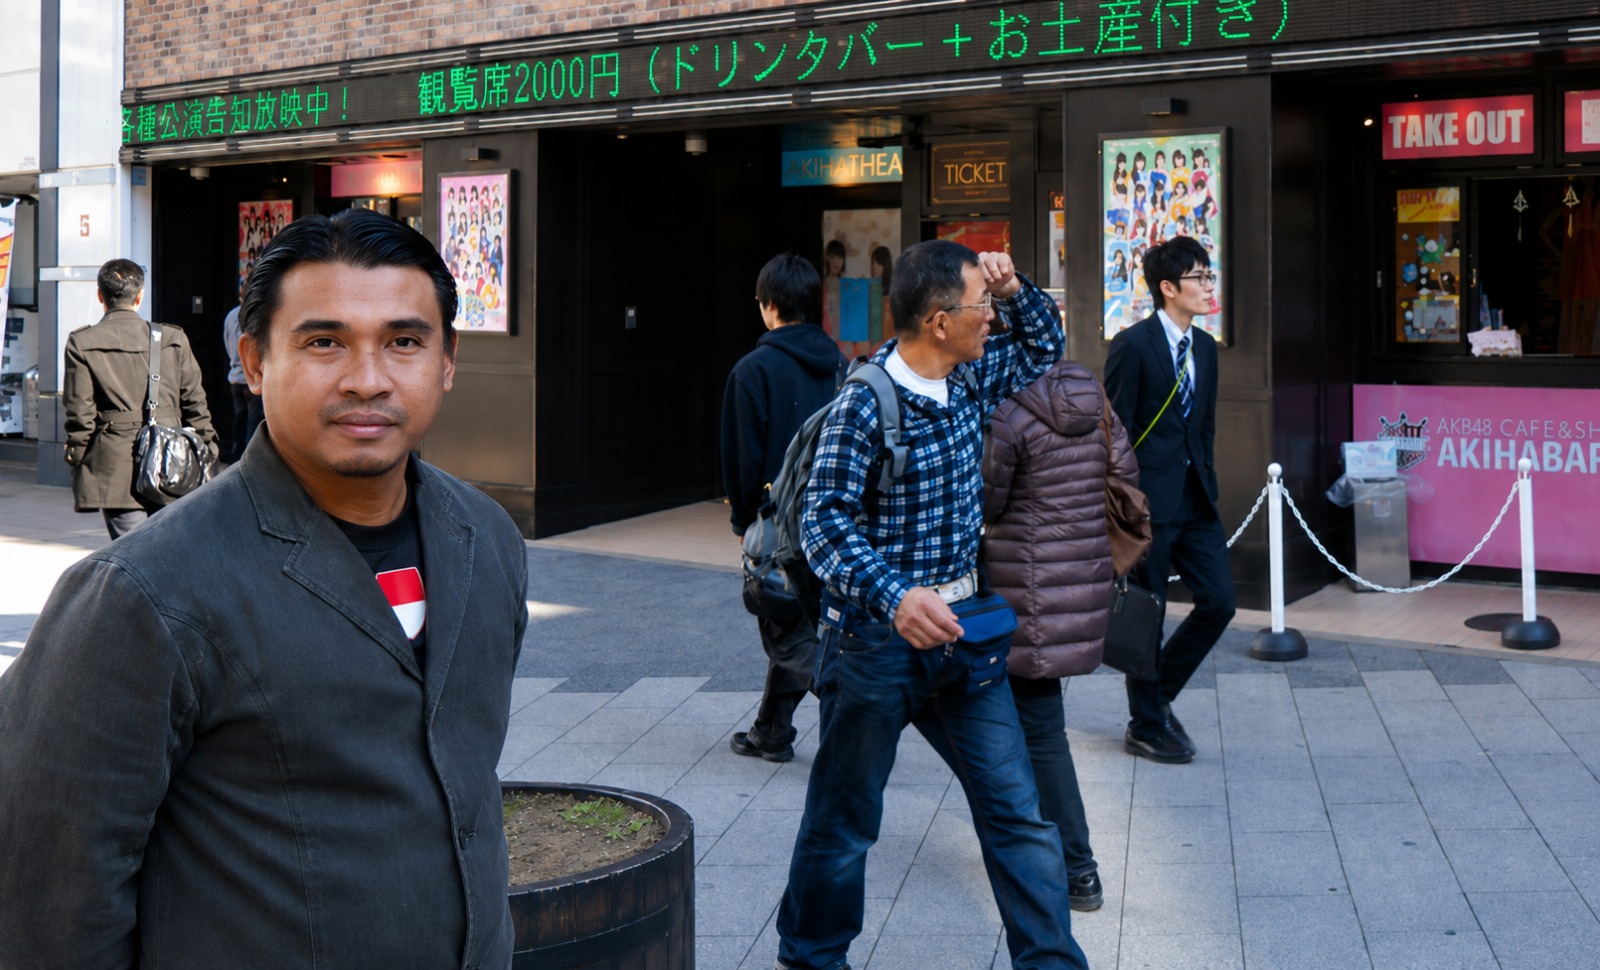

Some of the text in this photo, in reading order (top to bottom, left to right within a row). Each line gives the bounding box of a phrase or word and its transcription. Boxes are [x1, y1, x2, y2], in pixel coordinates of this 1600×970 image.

[1388, 108, 1525, 149] TAKE OUT
[944, 161, 1007, 184] TICKET
[80, 214, 89, 237] 5
[1436, 418, 1493, 435] AKB48
